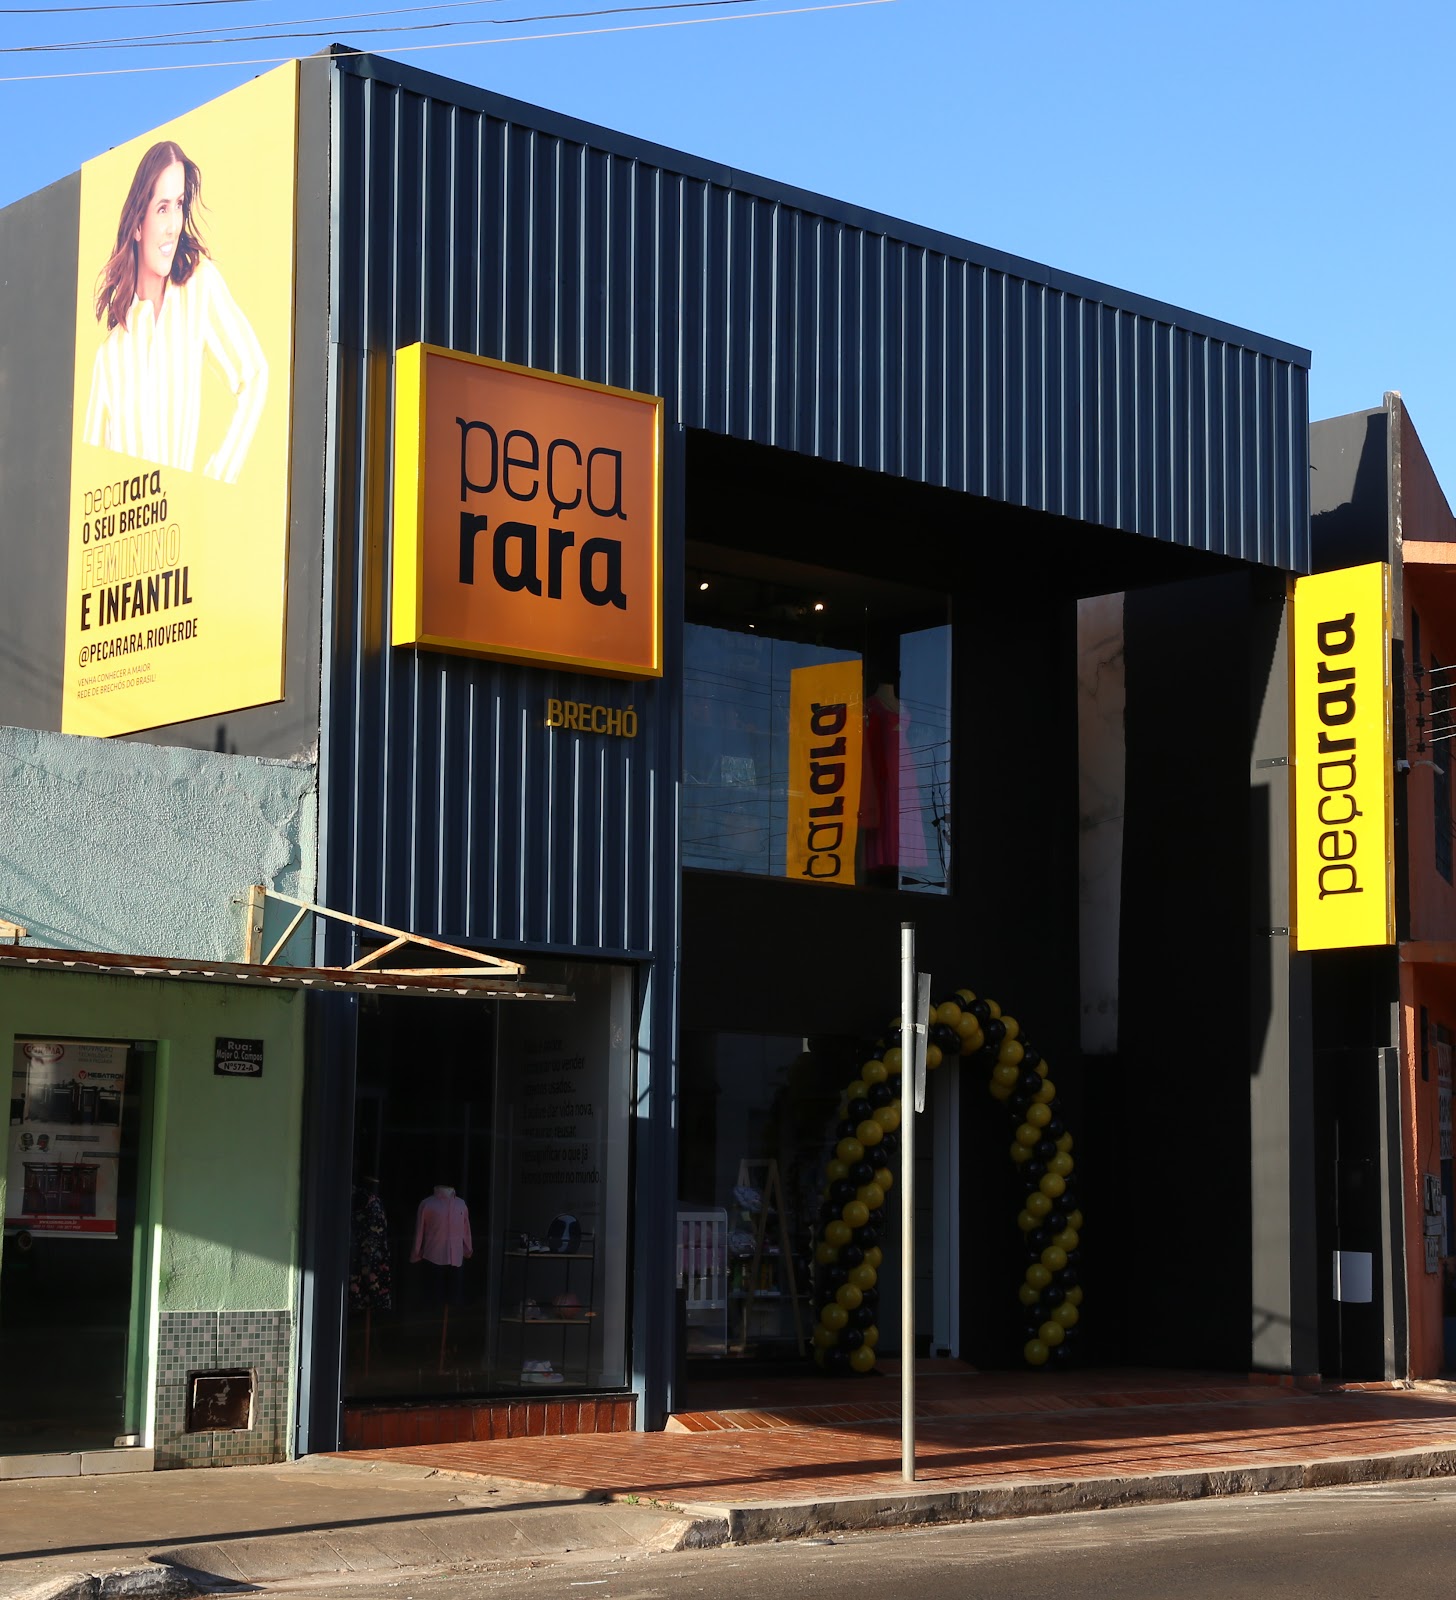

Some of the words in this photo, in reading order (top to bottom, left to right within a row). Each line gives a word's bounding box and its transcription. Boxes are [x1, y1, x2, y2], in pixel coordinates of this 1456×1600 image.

[456, 416, 627, 520] peça
[83, 522, 90, 544] O
[95, 514, 115, 541] SEU
[120, 491, 167, 534] BRECHÓ
[84, 470, 161, 520] peçarara
[81, 523, 181, 591] FEMININO
[459, 510, 627, 610] rara
[81, 593, 92, 632] E
[98, 566, 193, 627] INFANTIL
[79, 618, 198, 668] @PECARARA.RIOVERDE
[77, 675, 96, 688] VENHA
[97, 667, 127, 683] CONHECER
[127, 668, 132, 676] A
[132, 662, 151, 675] MAIOR
[77, 688, 91, 699] REDE
[92, 685, 99, 696] DE
[100, 679, 126, 695] BRECHÓS
[126, 678, 135, 689] DO
[546, 699, 638, 738] BRECHÓ
[1317, 613, 1363, 900] peçarara
[216, 1049, 233, 1061] Major
[241, 1051, 263, 1063] Campos
[227, 1041, 252, 1051] Rua:
